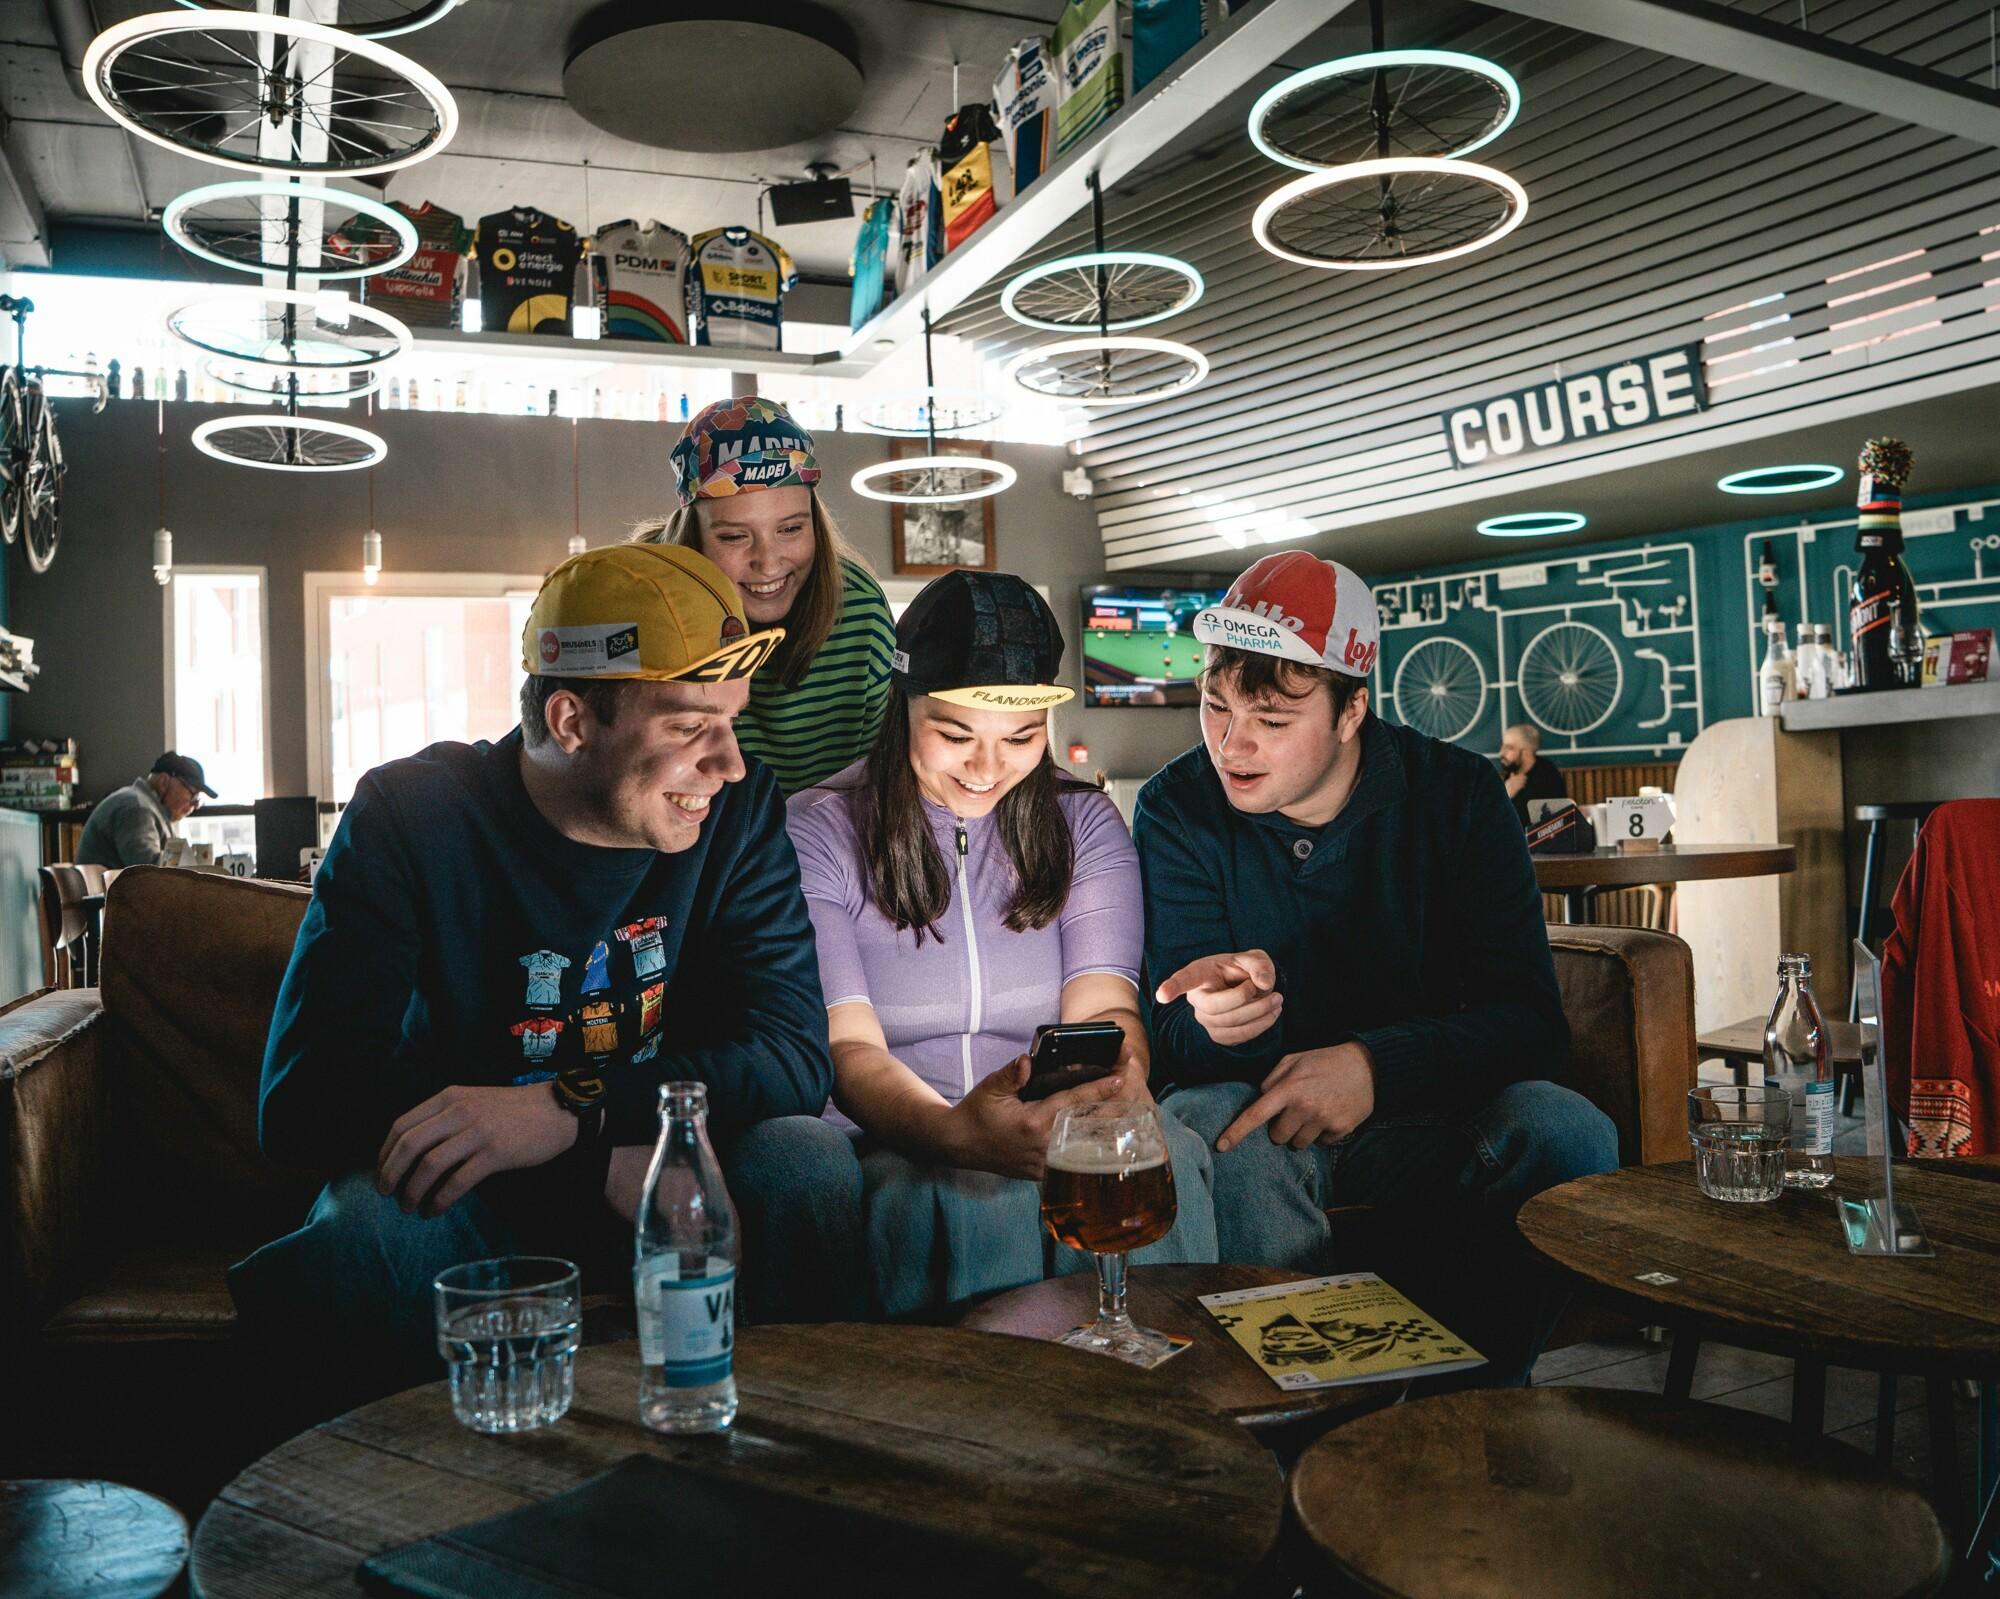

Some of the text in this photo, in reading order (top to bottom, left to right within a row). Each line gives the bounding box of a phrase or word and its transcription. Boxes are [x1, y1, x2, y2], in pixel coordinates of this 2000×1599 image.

[518, 252, 553, 263] direct
[615, 254, 658, 270] PDM
[518, 261, 564, 273] energie
[728, 301, 774, 318] Baloise
[1450, 350, 1698, 464] COURSE
[744, 462, 786, 481] MAPEI
[1224, 619, 1281, 638] OMEGA
[1227, 632, 1282, 650] PHARMA
[972, 691, 1068, 706] FLANDRIEN
[1629, 813, 1644, 837] 8
[230, 862, 245, 877] 10
